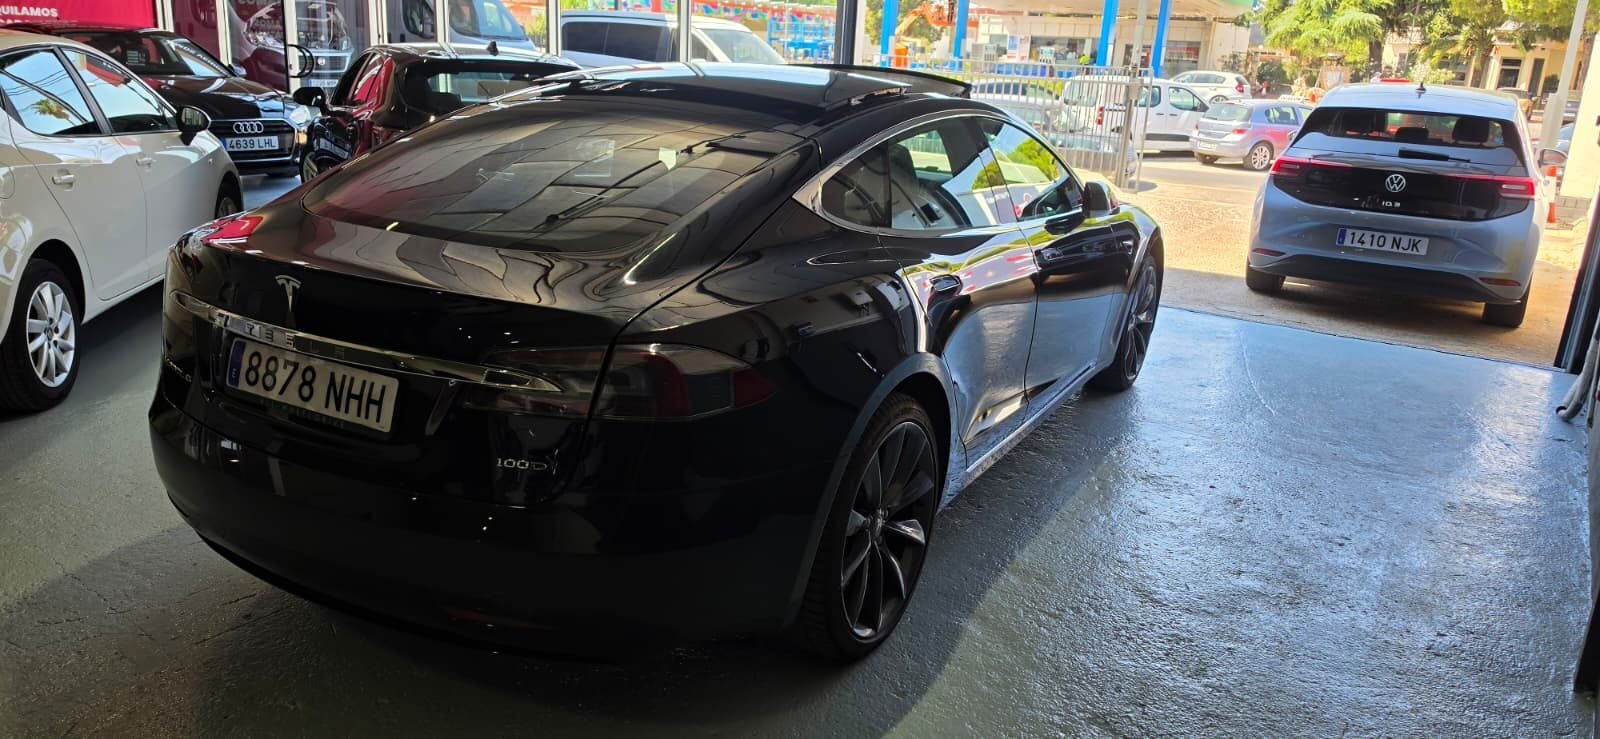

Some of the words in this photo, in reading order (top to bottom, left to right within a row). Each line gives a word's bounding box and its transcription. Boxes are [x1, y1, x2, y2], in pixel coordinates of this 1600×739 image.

[0, 5, 58, 17] UILAMOS
[229, 138, 255, 149] 4639
[258, 138, 276, 149] LHL
[1350, 231, 1386, 248] 1410
[1391, 236, 1422, 252] NJK
[245, 351, 316, 402] 8878
[324, 371, 386, 423] NHH
